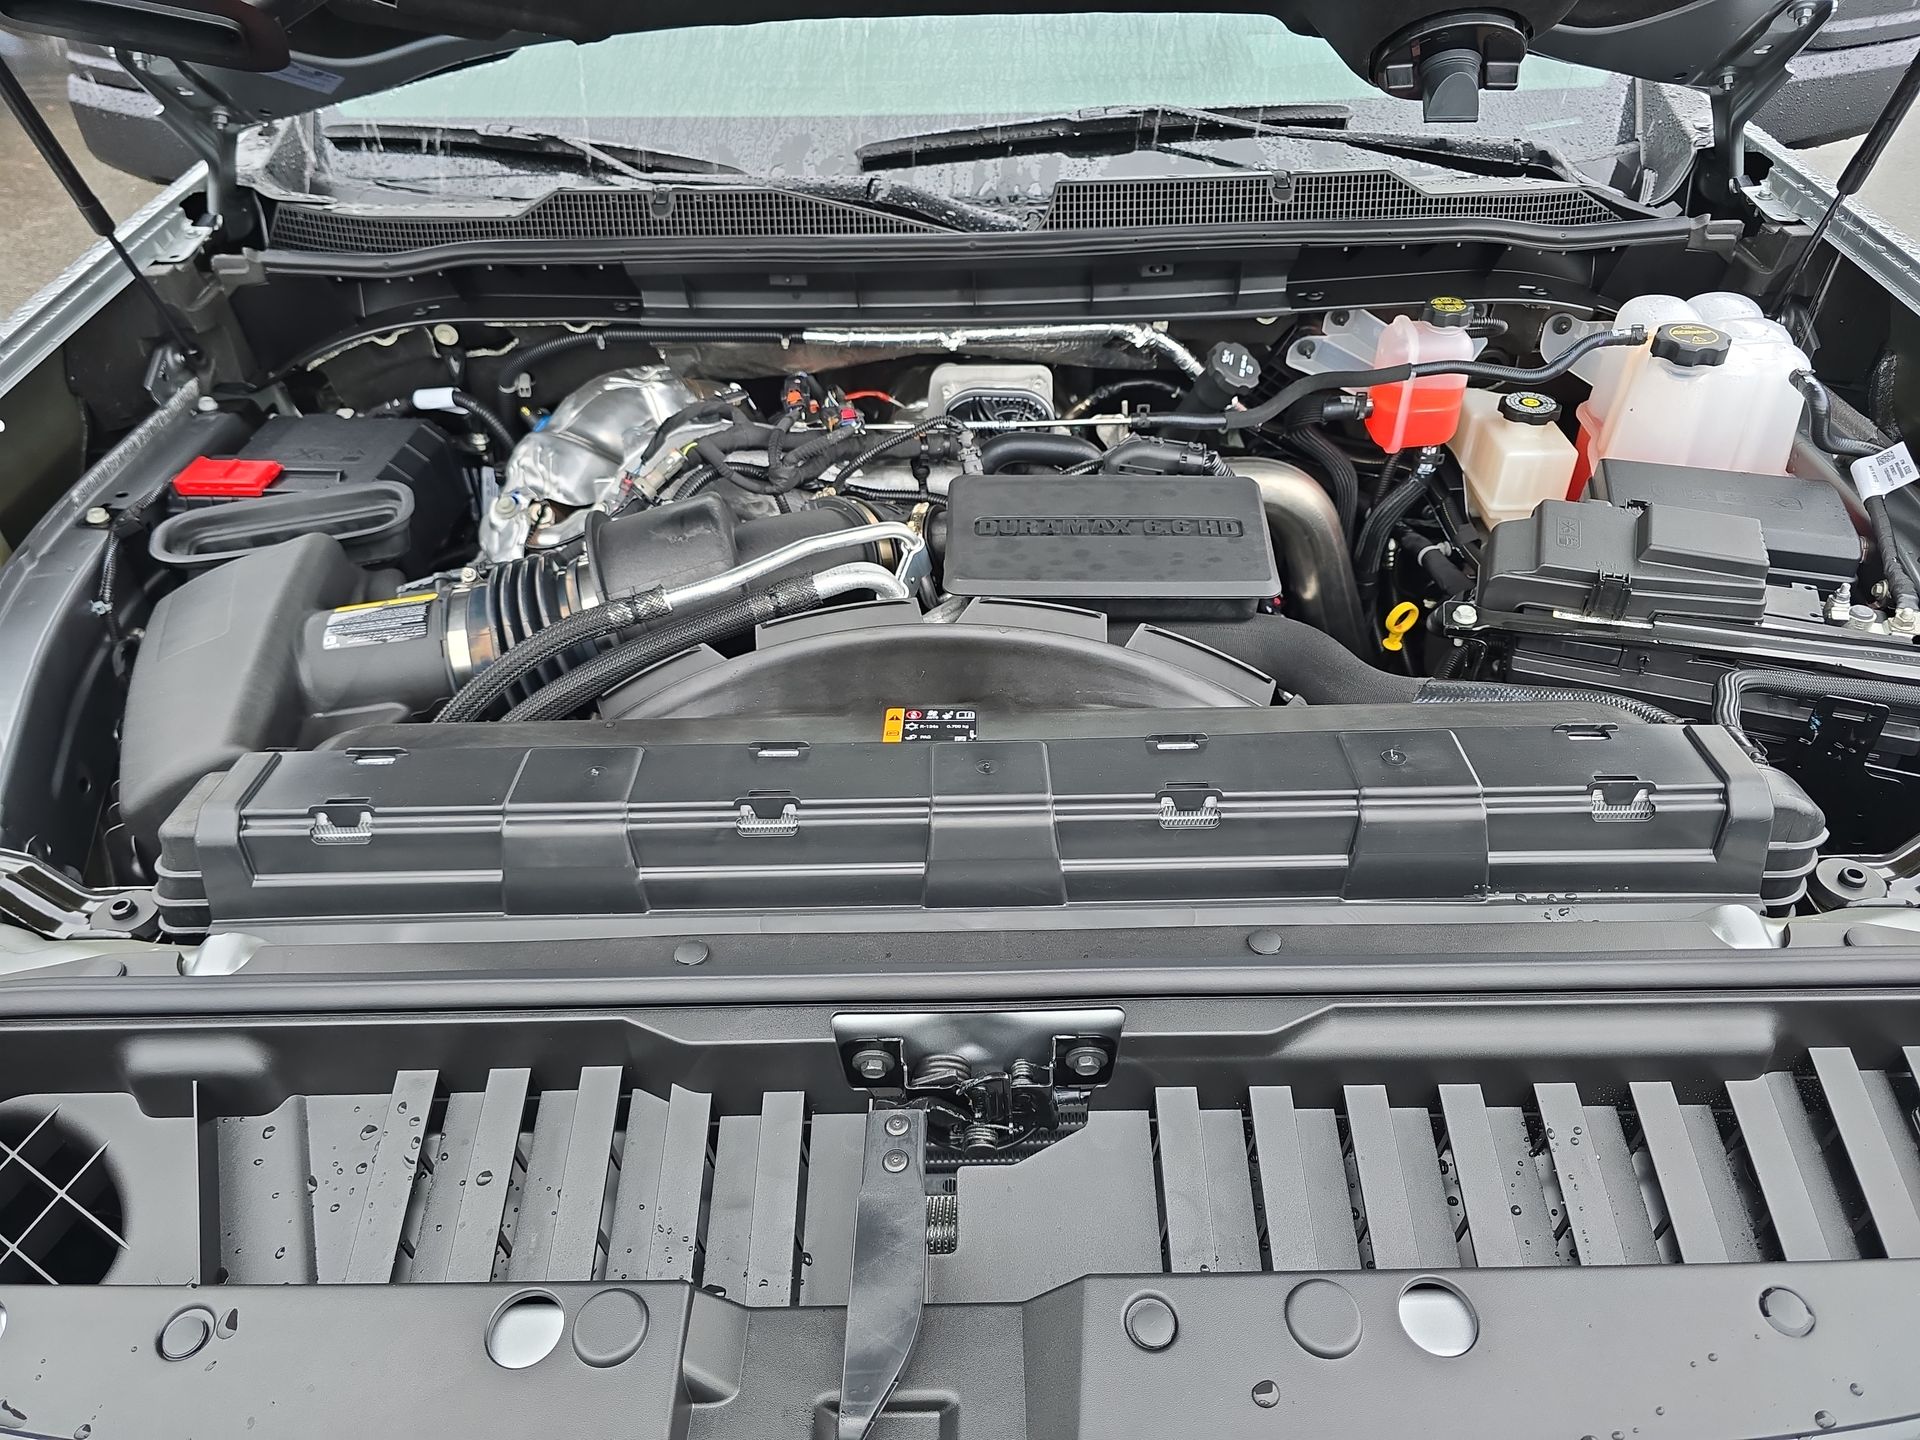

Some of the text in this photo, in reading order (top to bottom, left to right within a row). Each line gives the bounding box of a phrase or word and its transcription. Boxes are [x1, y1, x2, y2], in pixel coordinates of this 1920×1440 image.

[978, 519, 1241, 536] DURAMAX 6.6 HD
